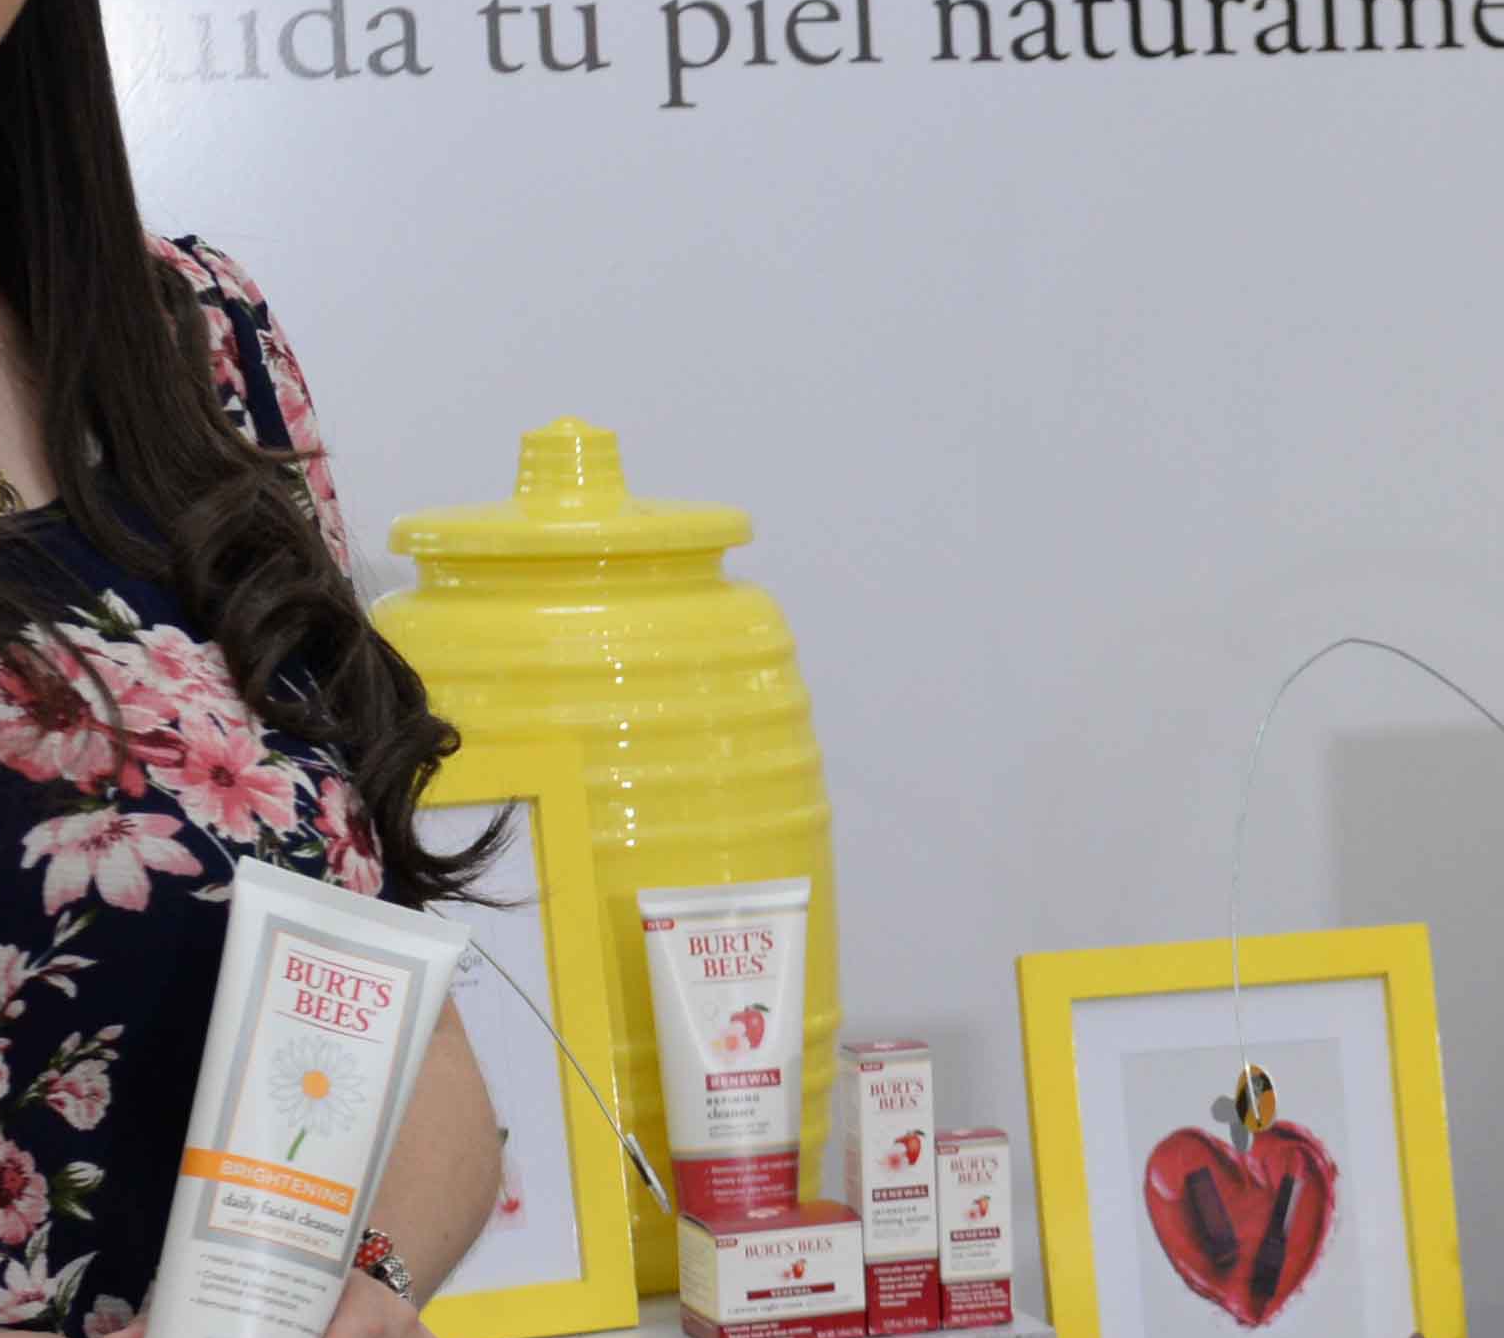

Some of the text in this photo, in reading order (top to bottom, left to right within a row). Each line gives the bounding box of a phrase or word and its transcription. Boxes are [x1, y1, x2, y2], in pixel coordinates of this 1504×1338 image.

[688, 929, 774, 956] BURT'S
[704, 954, 765, 978] BEES
[282, 955, 393, 1008] BURT'S
[294, 988, 372, 1033] BEES
[869, 1076, 924, 1097] BURT'S
[221, 1191, 258, 1212] daily
[262, 1199, 296, 1223] facial
